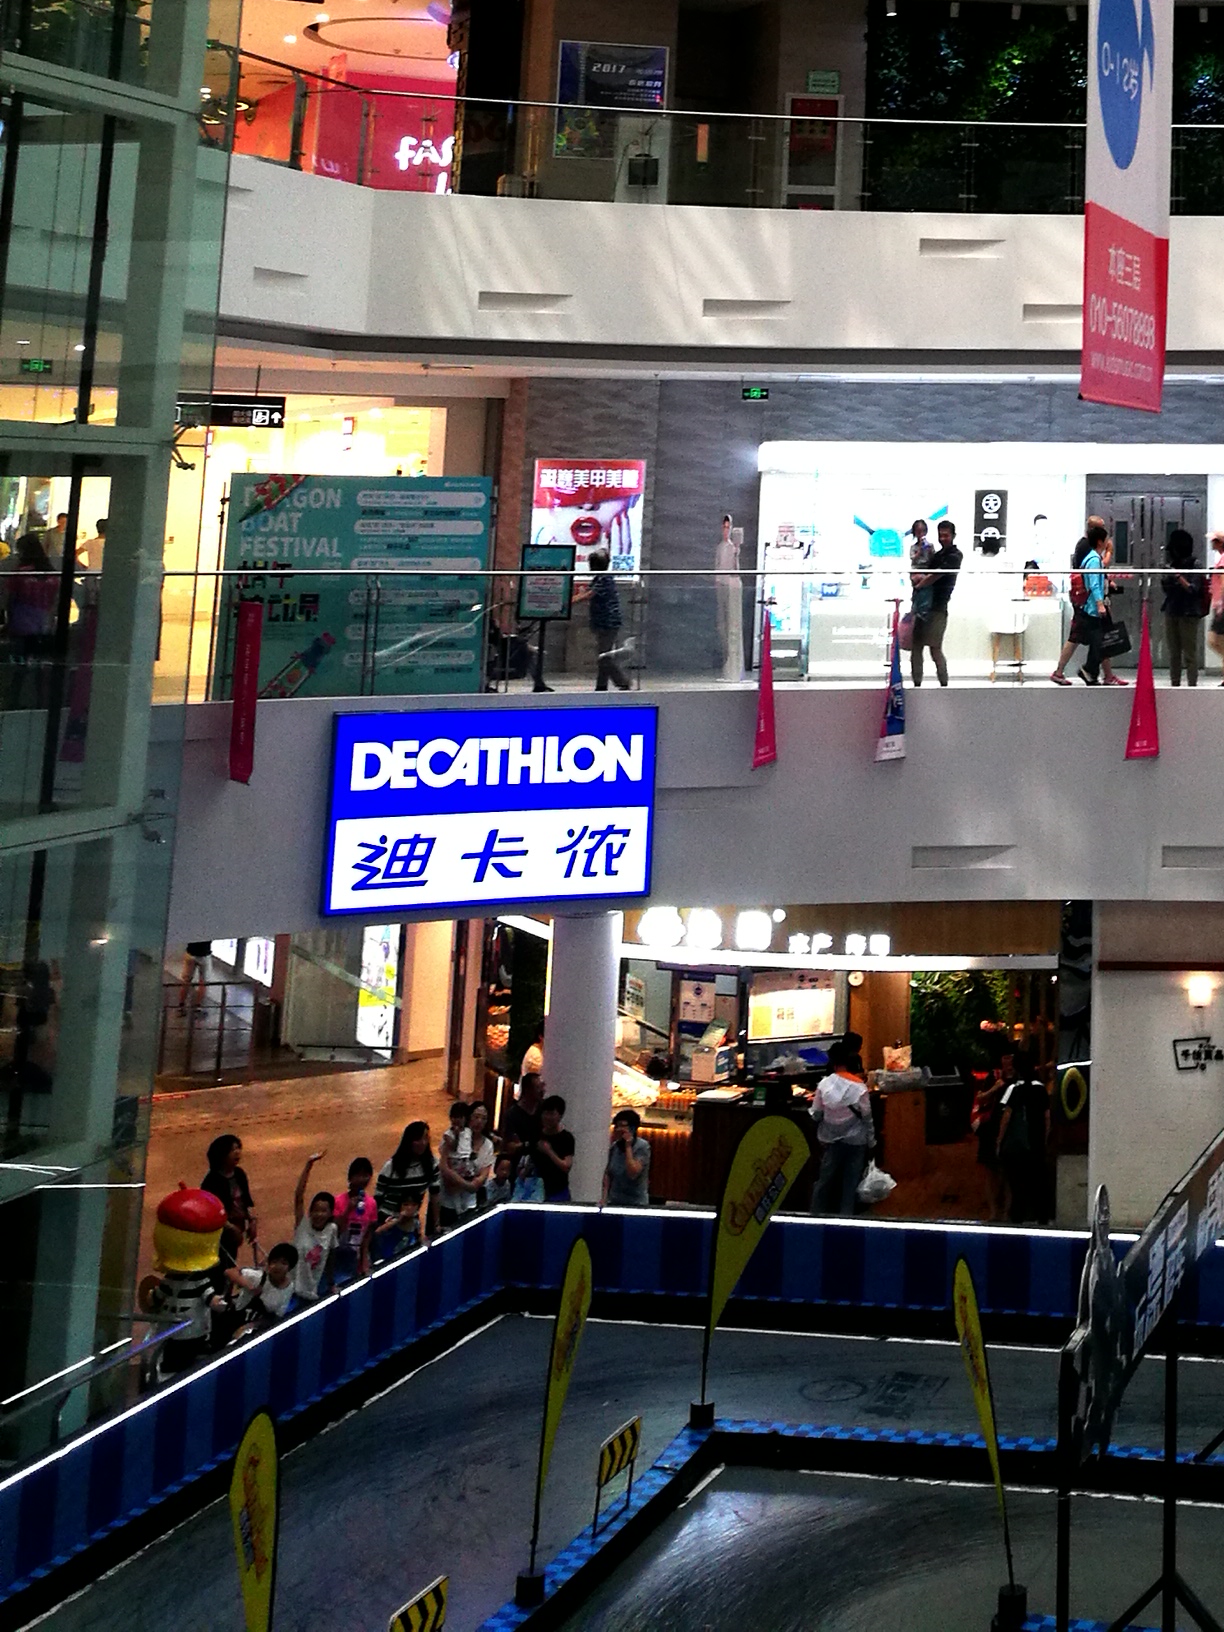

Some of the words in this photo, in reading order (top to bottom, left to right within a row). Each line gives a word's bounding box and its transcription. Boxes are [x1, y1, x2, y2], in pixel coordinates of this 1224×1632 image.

[239, 536, 343, 559] FESTIVAL
[350, 734, 645, 792] DECATHLON
[351, 824, 631, 892] 迪卡侬
